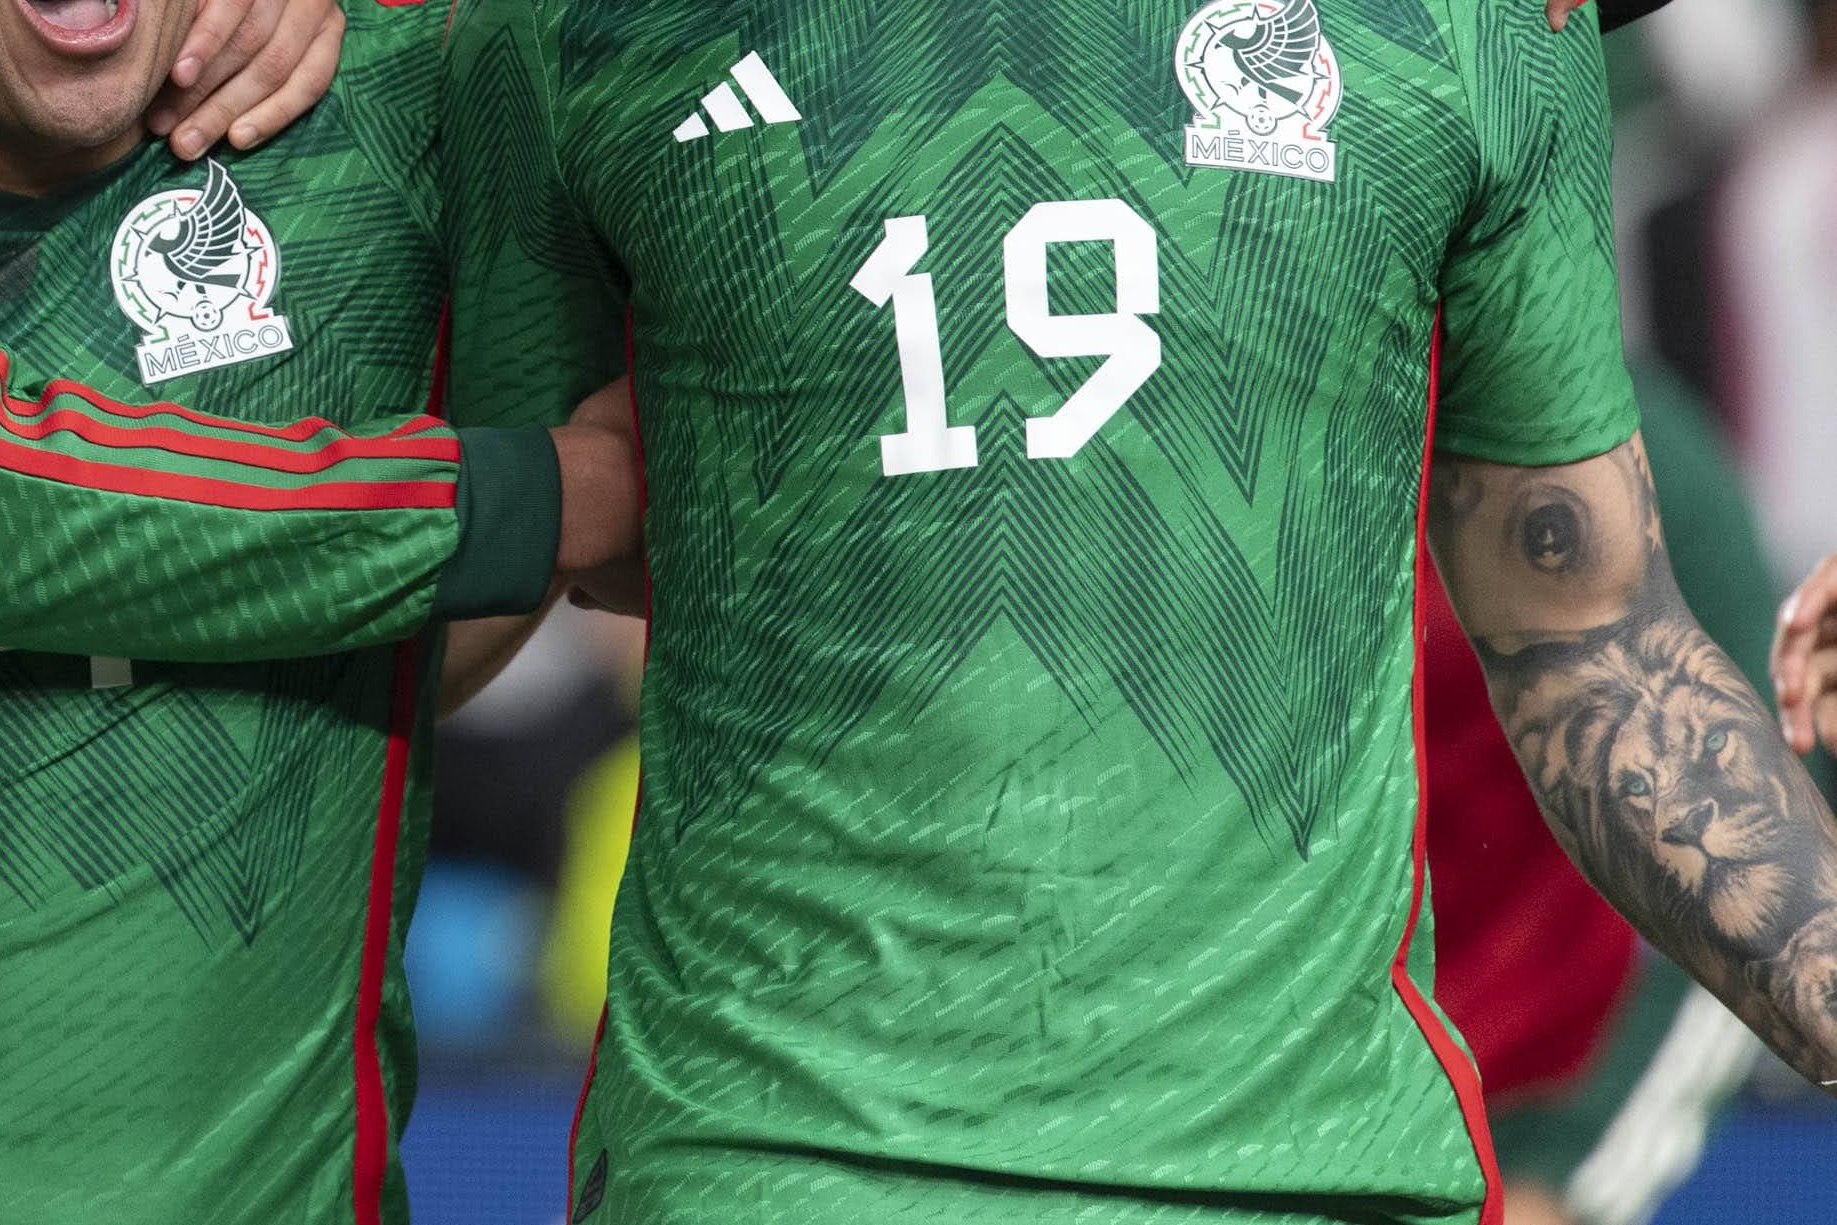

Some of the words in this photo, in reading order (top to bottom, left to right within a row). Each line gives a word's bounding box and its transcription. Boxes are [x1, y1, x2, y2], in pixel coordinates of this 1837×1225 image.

[1191, 130, 1329, 172] MÉXICO
[144, 325, 284, 376] MÉXICO
[849, 198, 1162, 476] 19
